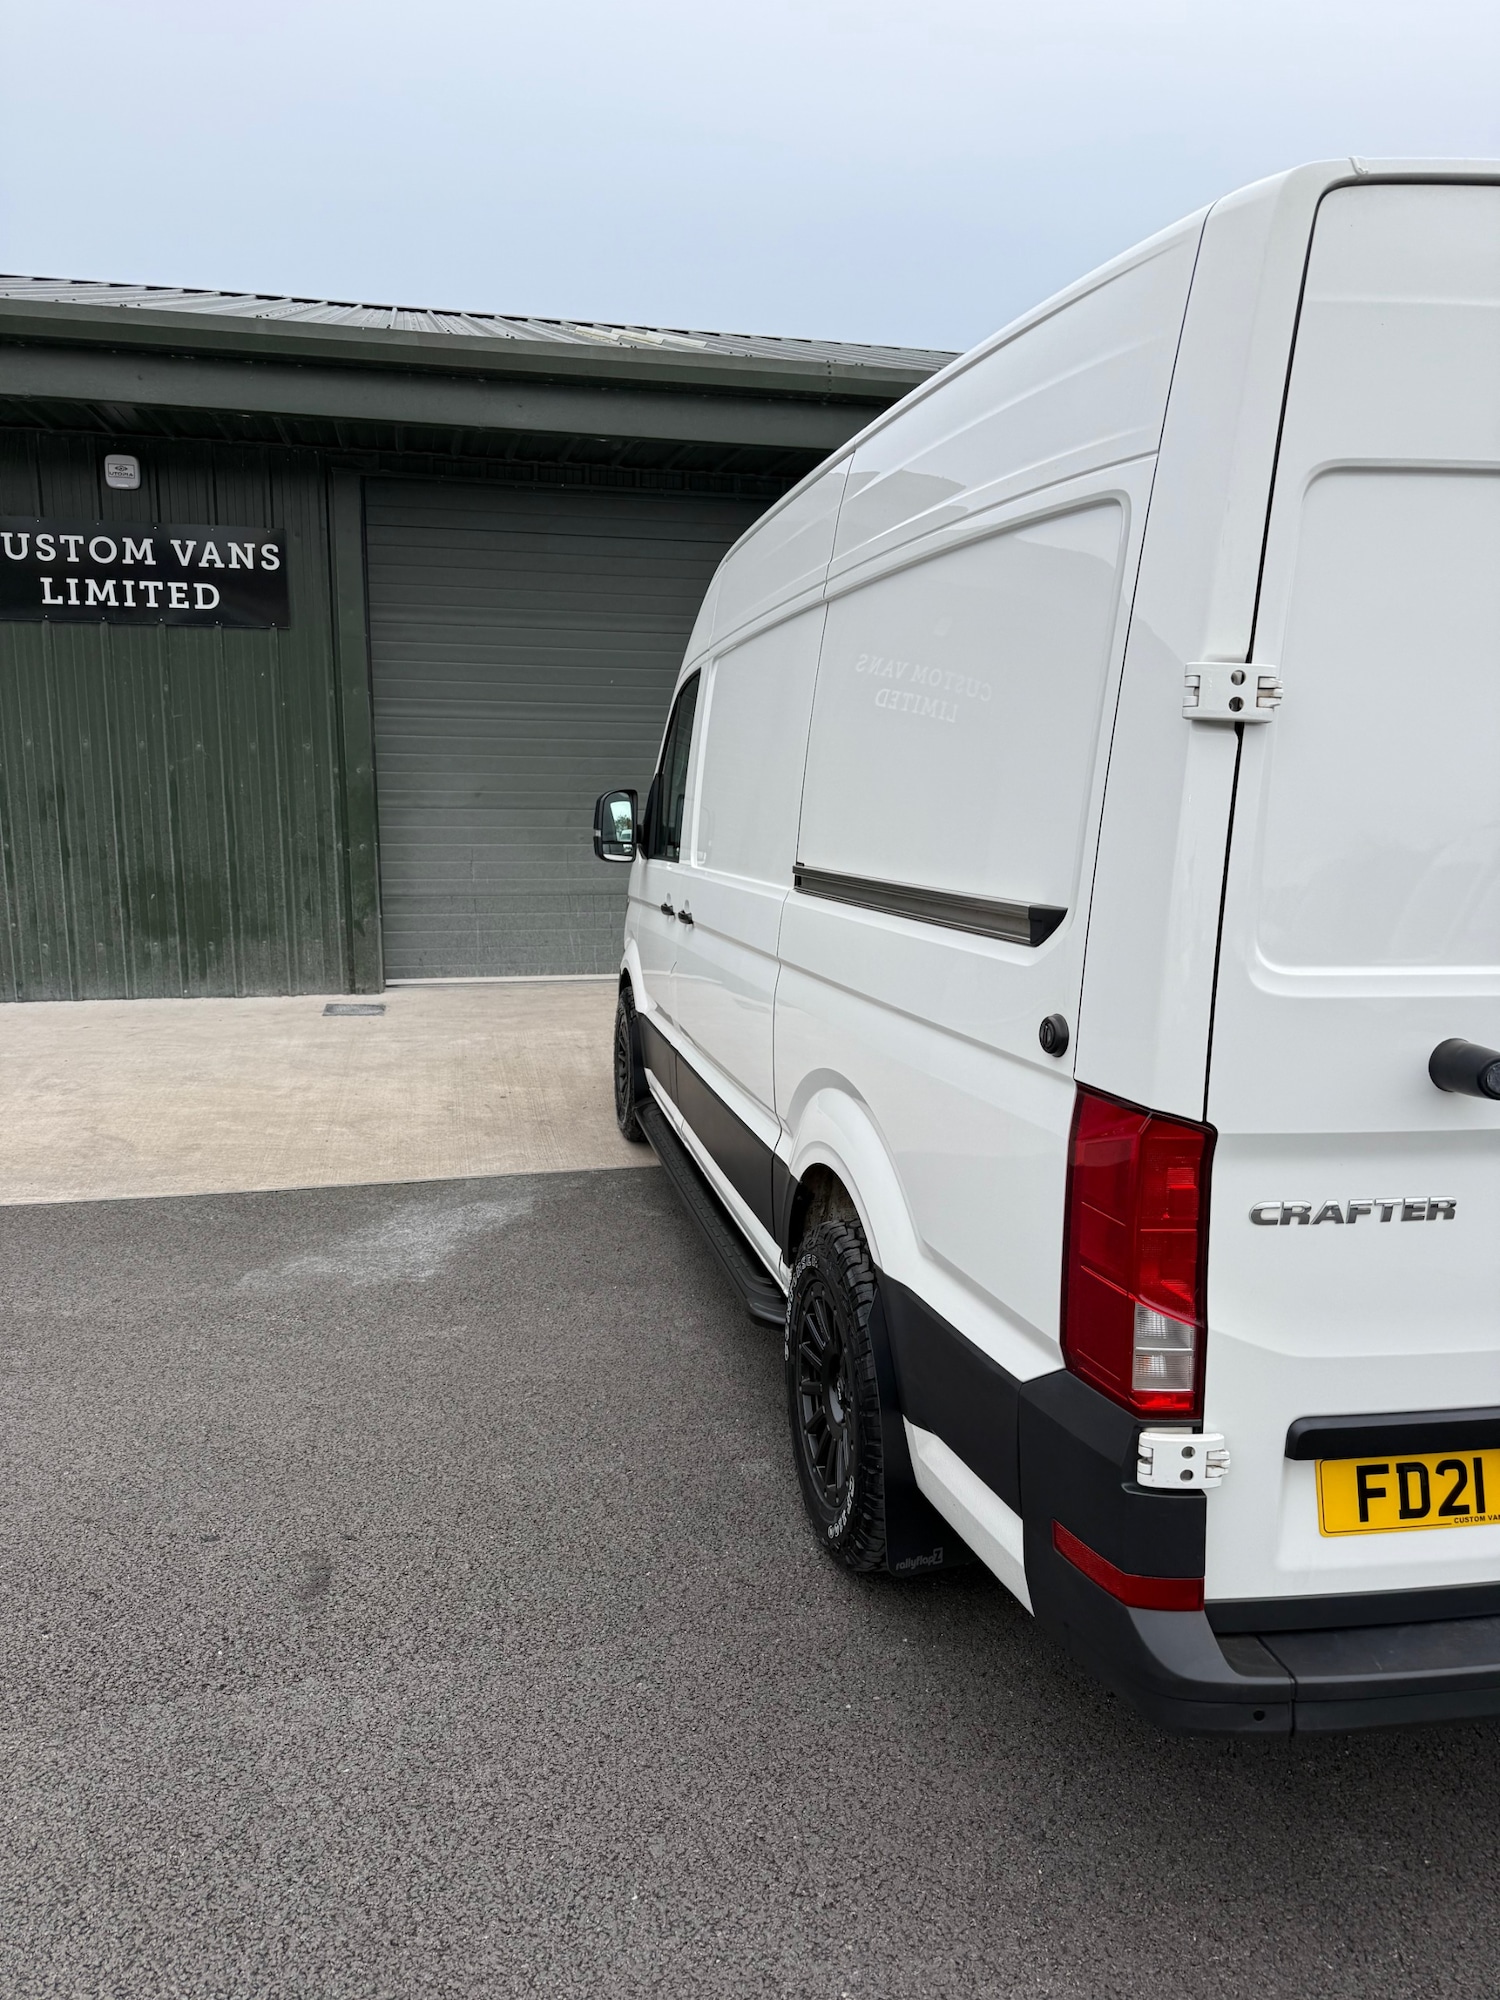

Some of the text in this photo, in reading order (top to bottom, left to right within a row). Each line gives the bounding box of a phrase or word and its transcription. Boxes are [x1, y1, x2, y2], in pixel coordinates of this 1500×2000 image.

[170, 539, 281, 571] VANS
[40, 577, 220, 610] LIMITED
[1248, 1195, 1457, 1226] CRAFTER
[1356, 1457, 1486, 1523] FD21
[1453, 1515, 1486, 1524] CUSTOM
